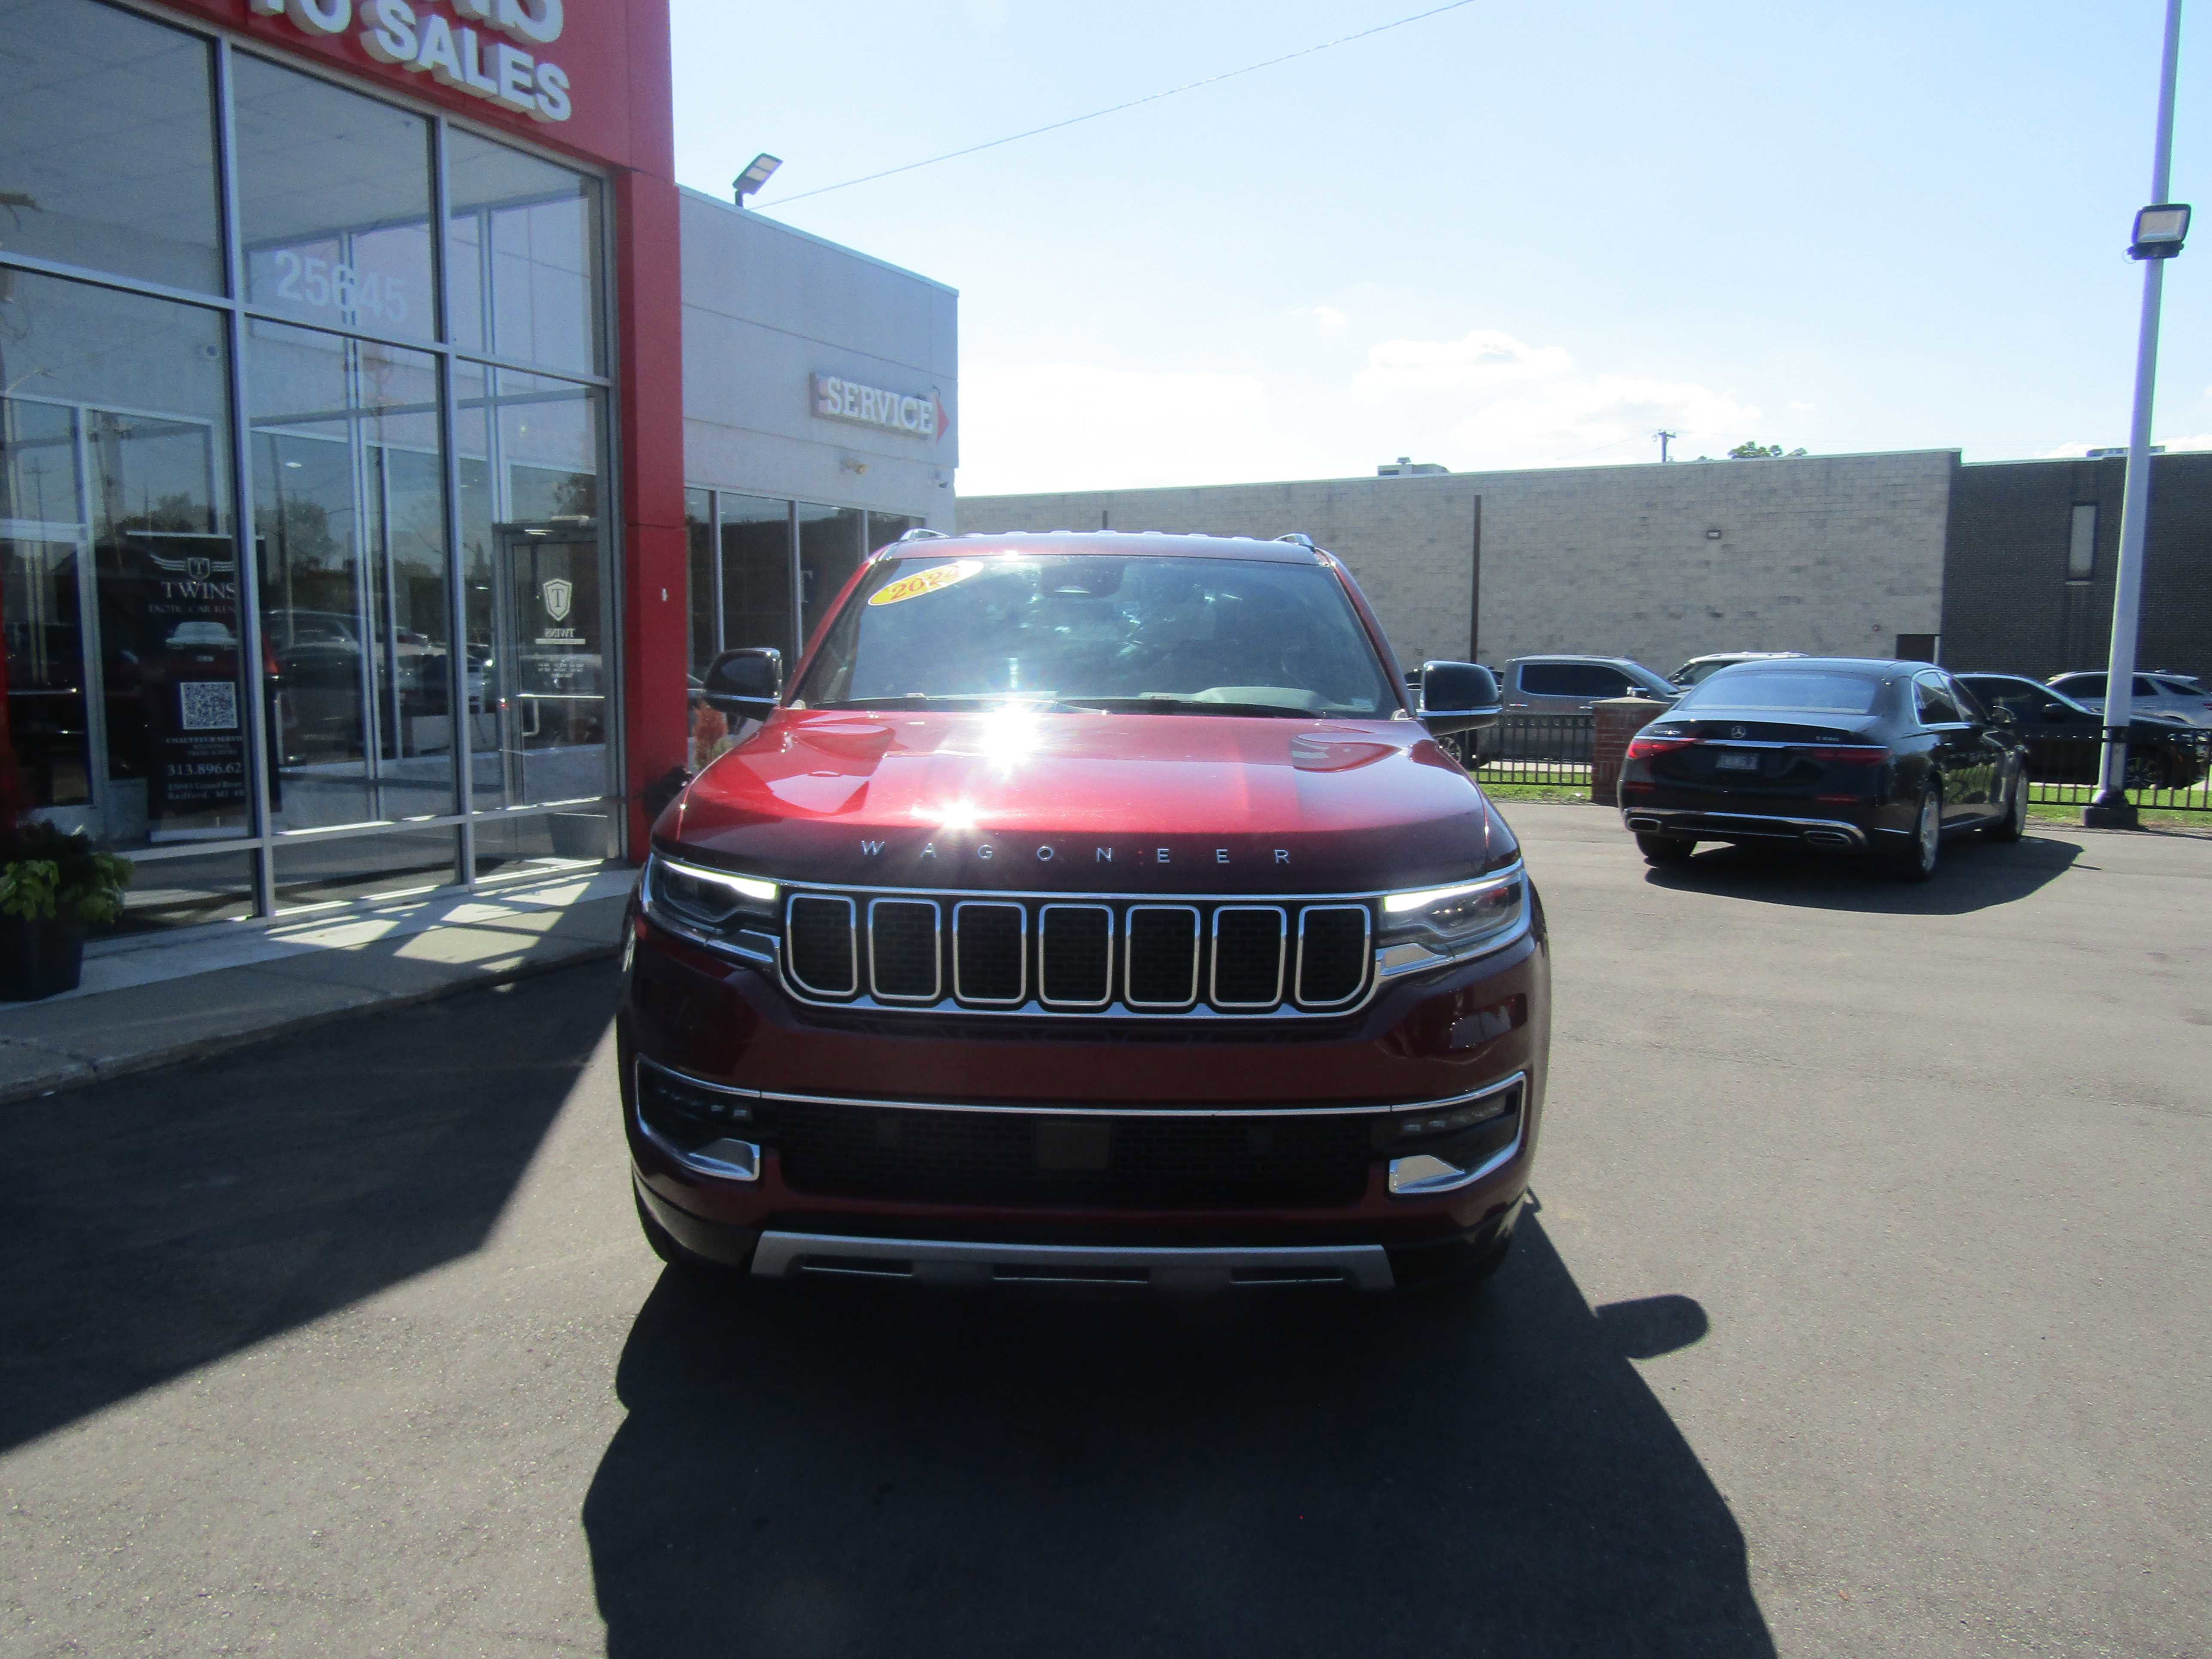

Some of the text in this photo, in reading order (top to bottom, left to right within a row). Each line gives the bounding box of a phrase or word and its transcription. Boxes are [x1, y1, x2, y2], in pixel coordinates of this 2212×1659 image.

[360, 0, 571, 122] SALES
[275, 250, 407, 322] 25645
[820, 376, 933, 434] SERVICE
[161, 581, 235, 599] TWINS
[167, 762, 242, 776] 313.896.62
[860, 840, 1290, 864] WAGONEER
